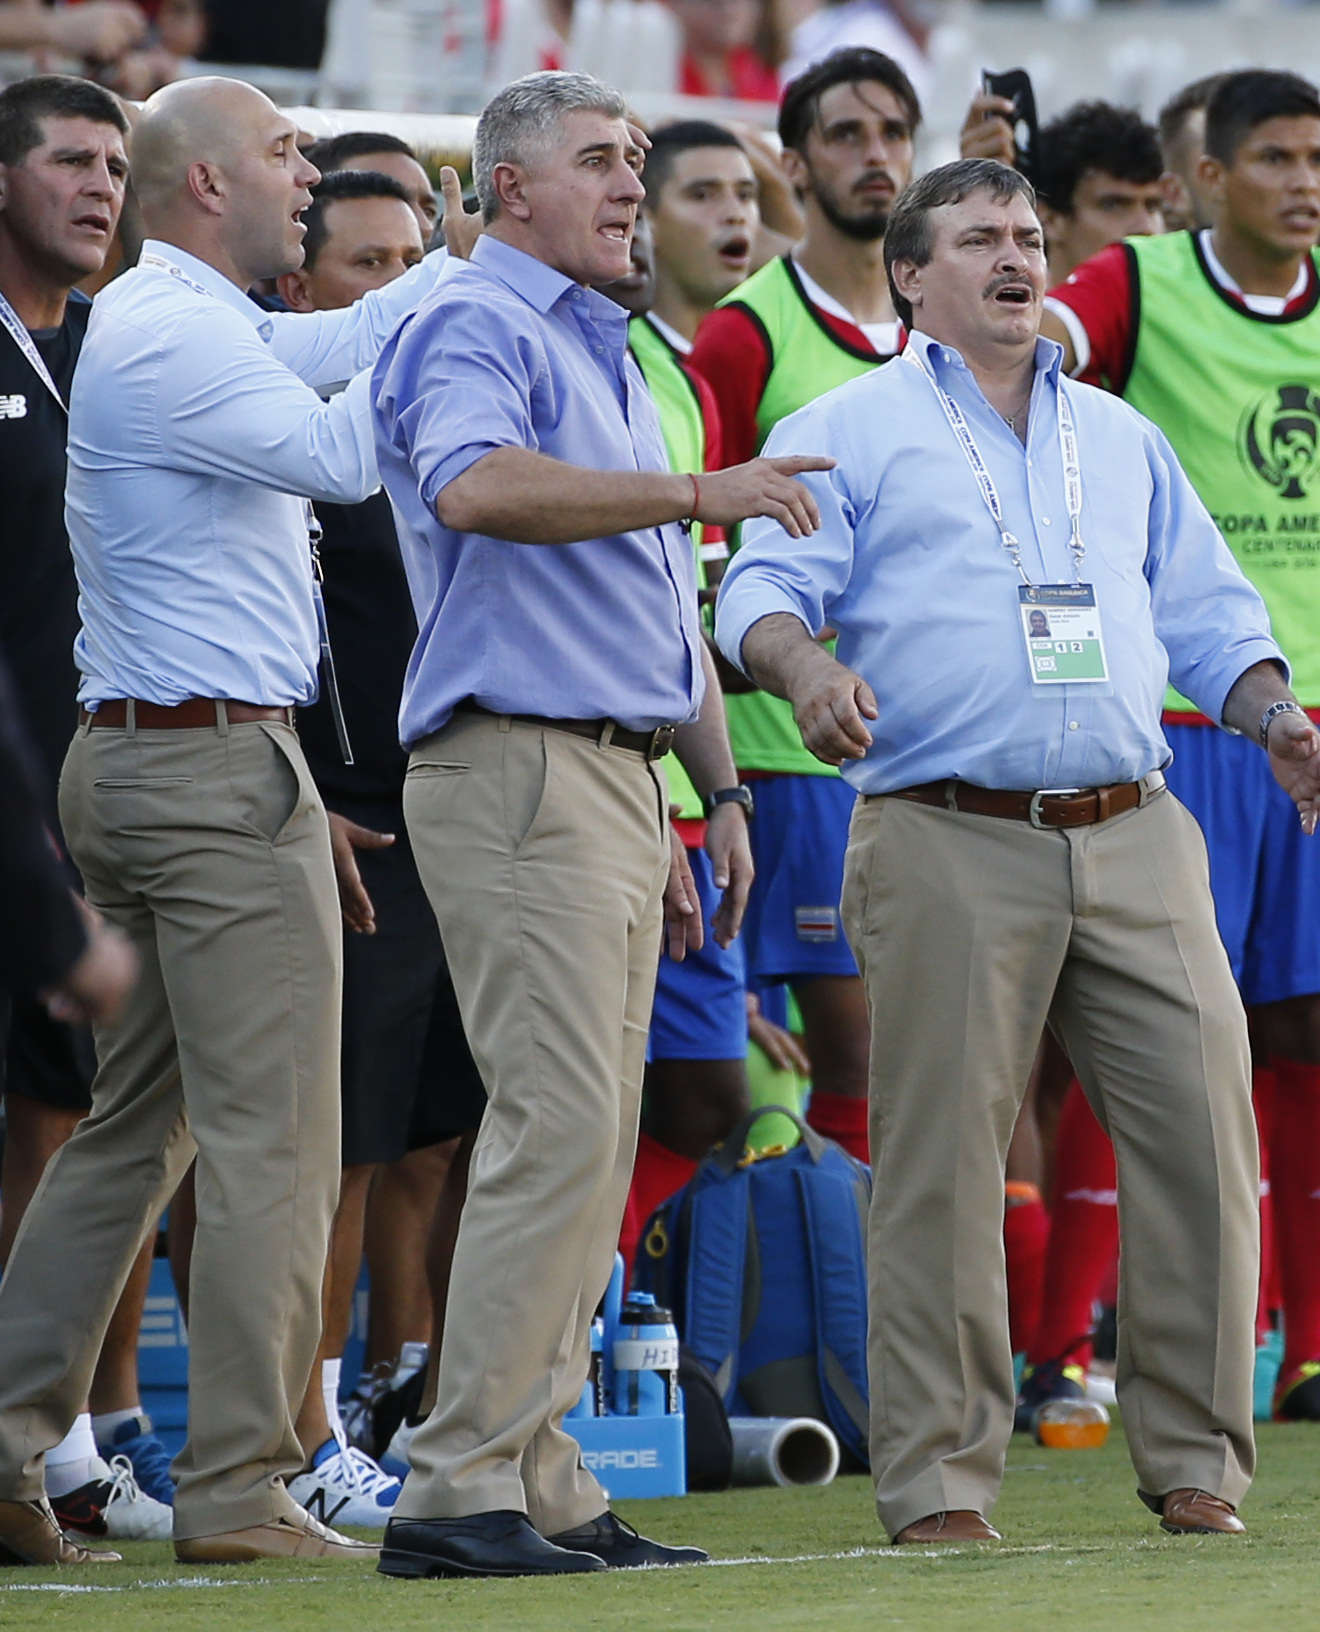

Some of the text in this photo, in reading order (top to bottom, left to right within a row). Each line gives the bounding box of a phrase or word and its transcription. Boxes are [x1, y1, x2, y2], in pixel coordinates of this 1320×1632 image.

[1057, 643, 1064, 651] 1
[1072, 642, 1081, 652] 2
[304, 1487, 350, 1525] N
